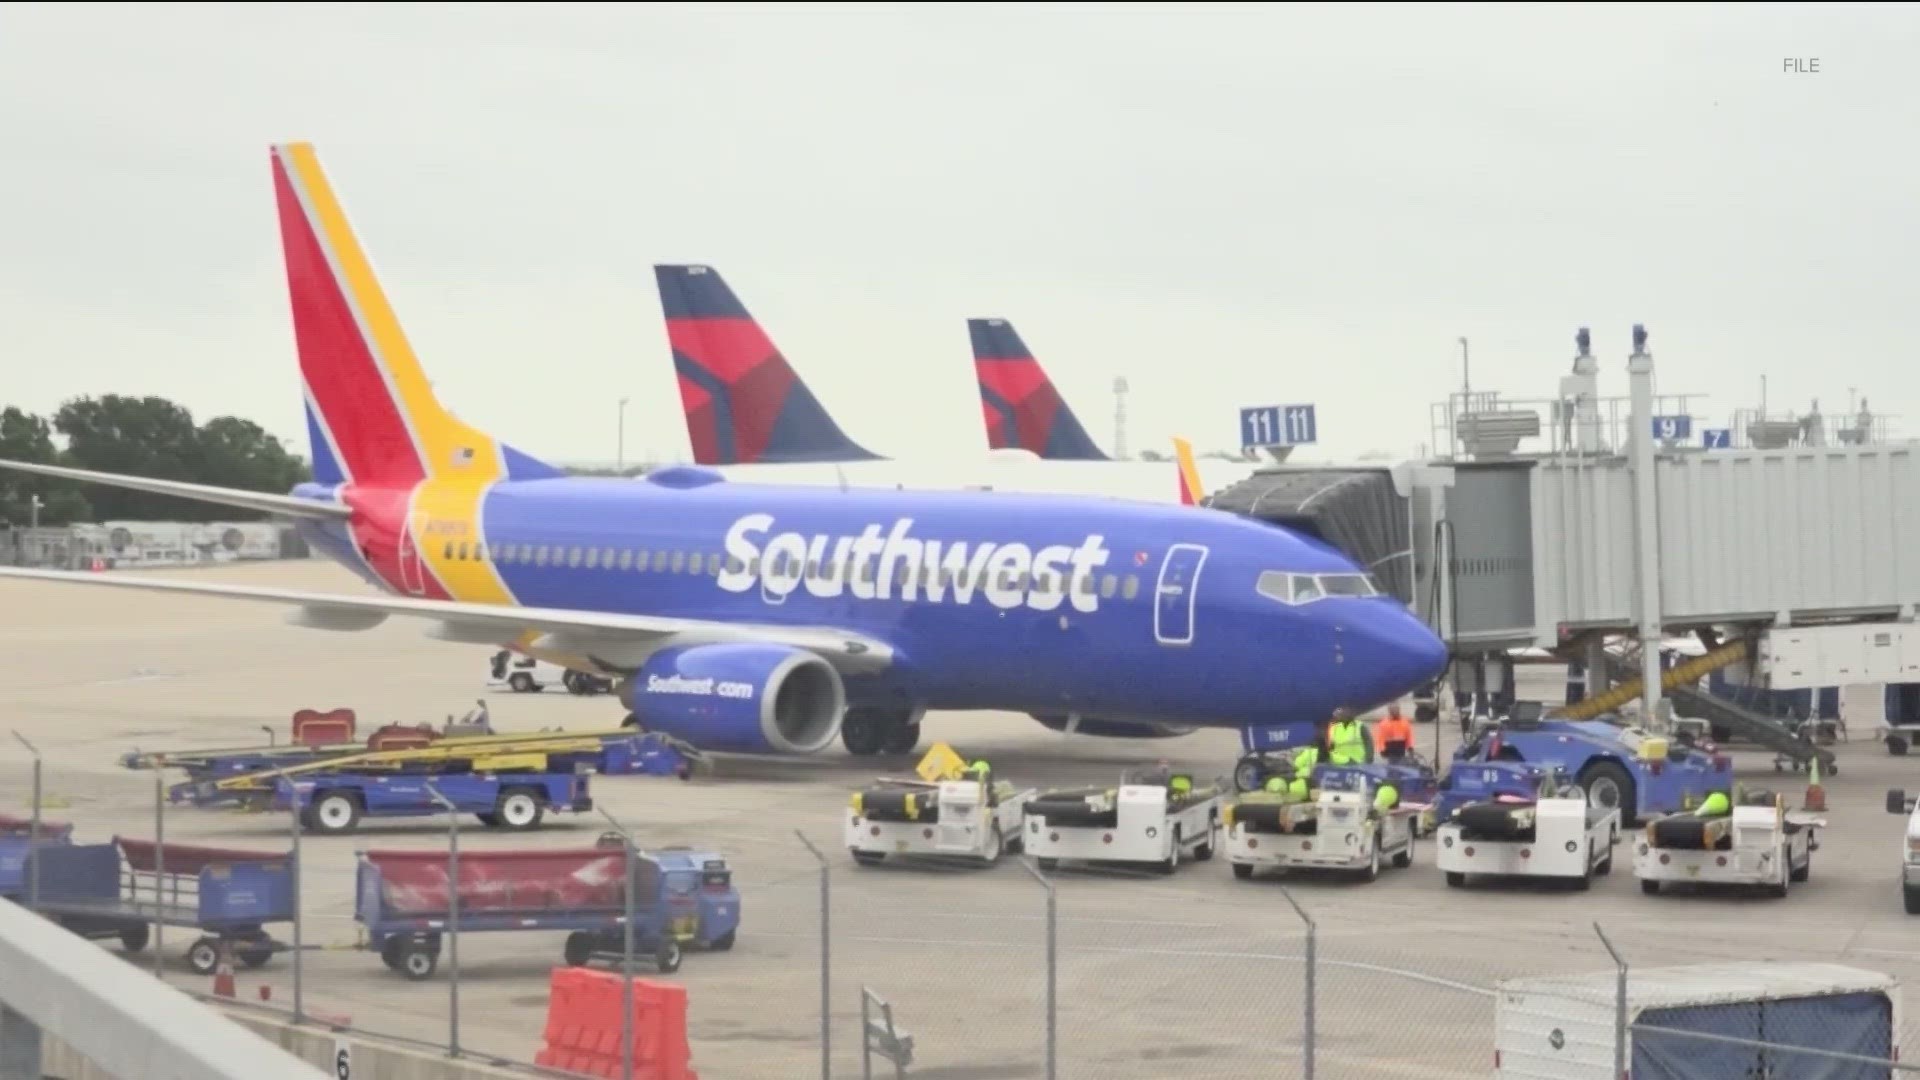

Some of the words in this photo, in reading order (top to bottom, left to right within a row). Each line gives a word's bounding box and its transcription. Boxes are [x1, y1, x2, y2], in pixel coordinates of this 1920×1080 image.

[1248, 409, 1271, 443] 11
[1288, 408, 1308, 441] 11
[1661, 418, 1676, 438] 9
[1709, 430, 1722, 448] 7
[717, 513, 1111, 612] Southwest
[337, 1049, 350, 1080] 6
